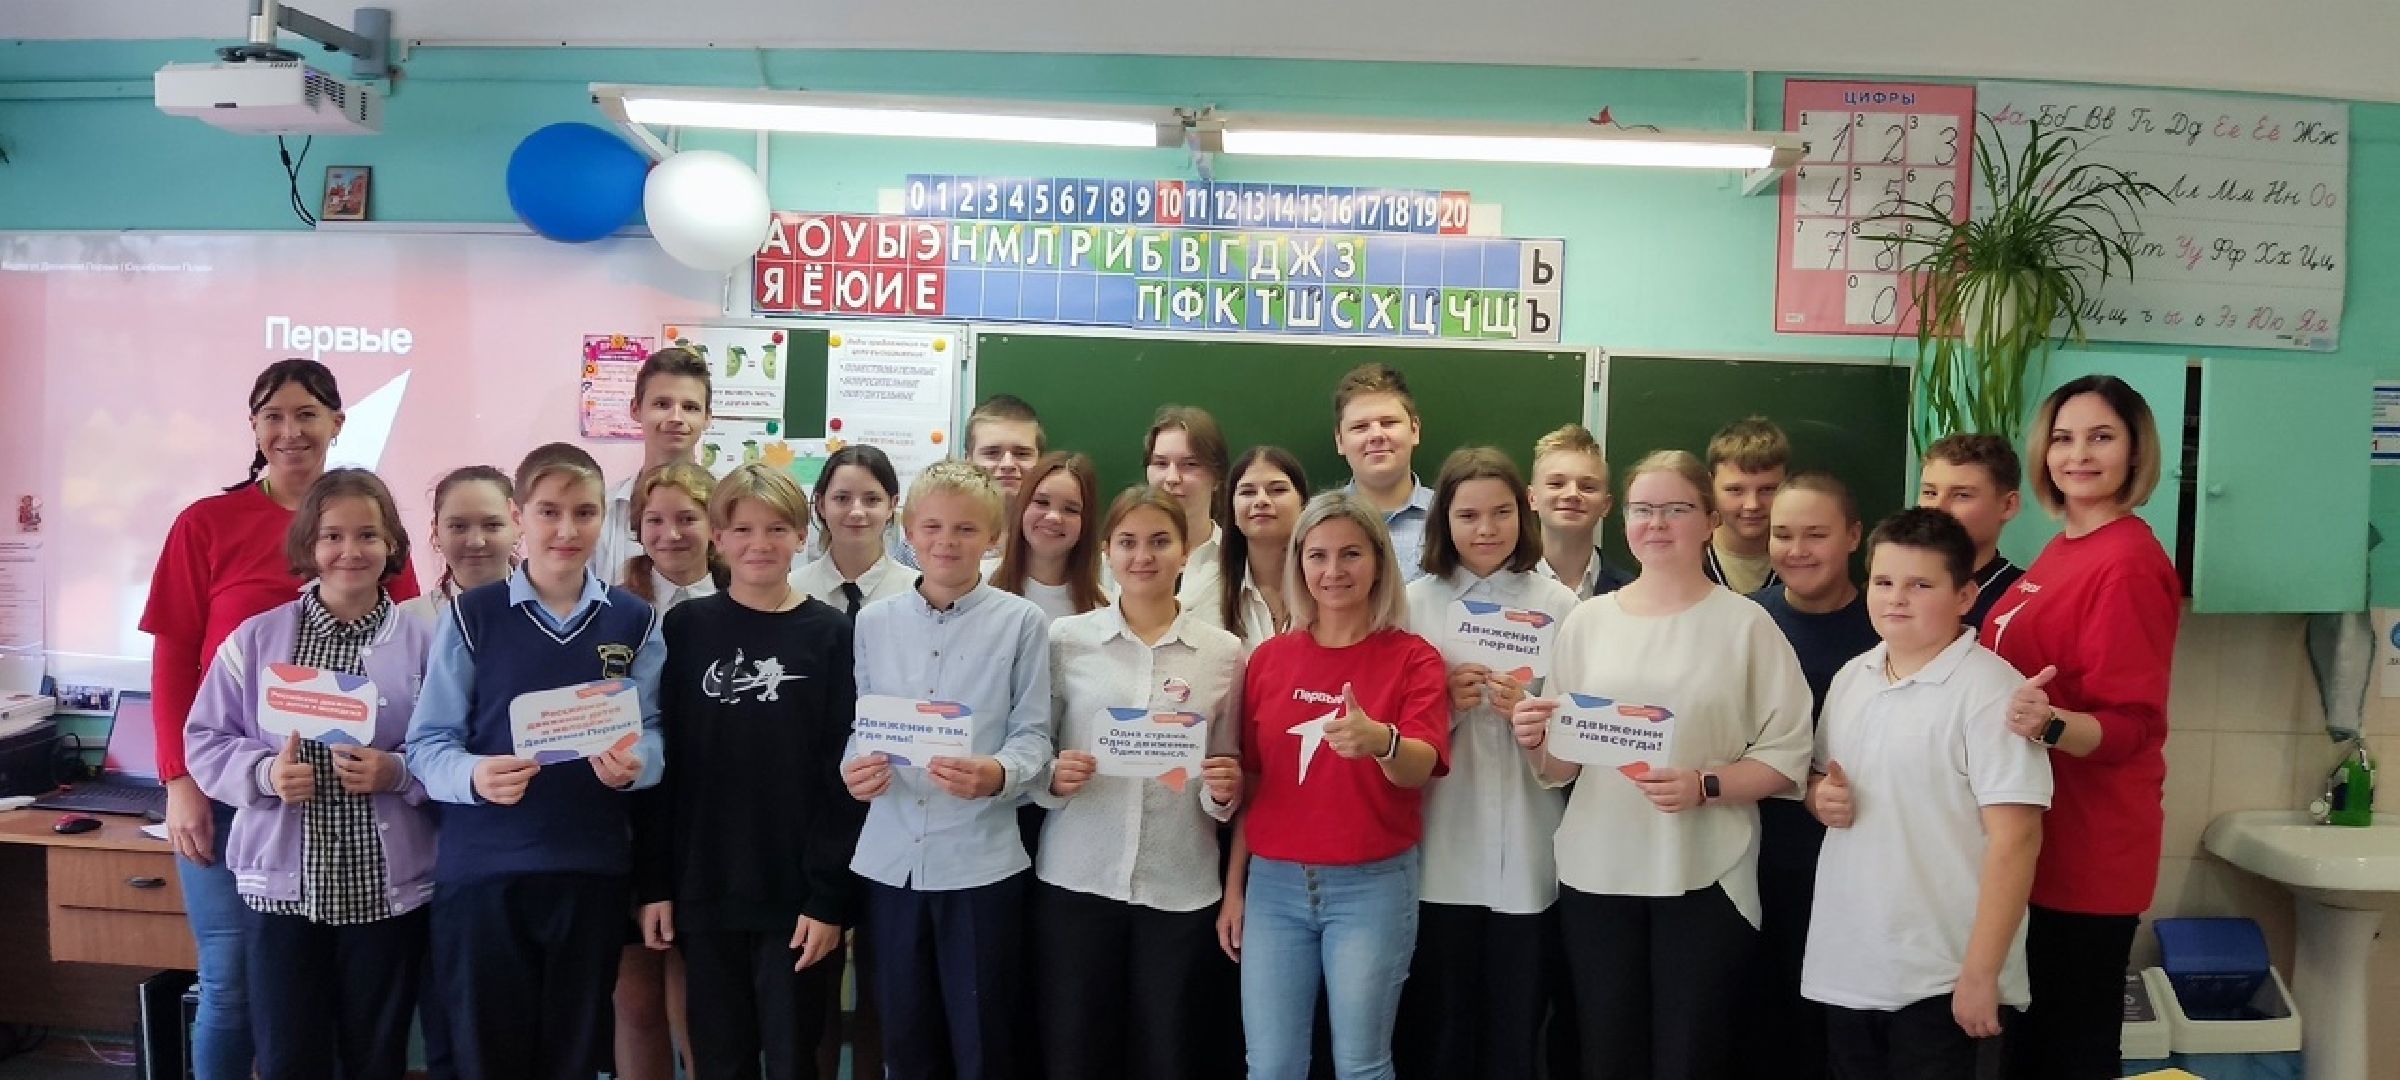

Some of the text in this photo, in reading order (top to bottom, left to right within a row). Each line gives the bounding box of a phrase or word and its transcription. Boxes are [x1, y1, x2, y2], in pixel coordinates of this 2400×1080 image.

[1844, 91, 1915, 105] ЦИФРЫ
[1801, 113, 1918, 129] 1 2 3
[2037, 104, 2078, 128] Бб
[2085, 105, 2116, 130] Вв
[2128, 108, 2154, 135] Гг
[2164, 112, 2203, 146] Дд
[2213, 115, 2241, 139] Ее
[2293, 120, 2340, 145] Жж
[1831, 123, 1958, 166] 1 2 3
[1797, 168, 1916, 182] 4 5 6
[1828, 177, 1955, 217] 4 5 6
[2163, 174, 2199, 203] Лл
[2208, 179, 2255, 203] Мм
[2262, 180, 2301, 205] Нн
[2310, 183, 2337, 208] Оо
[911, 182, 1467, 228] 0 1 2 3 4 5 6 7 8 9 10 11 12 13 14 15 16 17 18 19 20
[1796, 221, 1804, 233] 7
[760, 219, 1554, 284] А О У Ы Э Н М Л Р Й Б В Г Д Ж З Ь
[1826, 231, 1846, 269] 7
[2176, 235, 2204, 272] Уу
[2211, 237, 2247, 271] Фф
[2254, 241, 2292, 266] Хх
[2299, 244, 2335, 272] Цц
[1848, 275, 1857, 288] 0
[763, 264, 1551, 338] Я Ё Ю И Е П Ф К Т Ш С Х Ц Ч Щ Ъ
[1871, 286, 1898, 324] 0
[2080, 297, 2128, 325] Щщ
[2140, 308, 2152, 325] ъ
[2215, 304, 2237, 329] Ээ
[2248, 307, 2285, 331] Юю
[2294, 308, 2329, 334] Яя
[265, 316, 413, 358] Первые
[1458, 622, 1538, 643] Движение
[1478, 639, 1540, 655] первых!
[857, 717, 969, 737] Движение там,
[858, 731, 882, 740] где
[885, 733, 914, 743] мы!
[1110, 728, 1142, 739] Одна
[1560, 715, 1664, 738] В движении
[1109, 747, 1142, 756] Один
[1579, 732, 1663, 751] навсегда!
